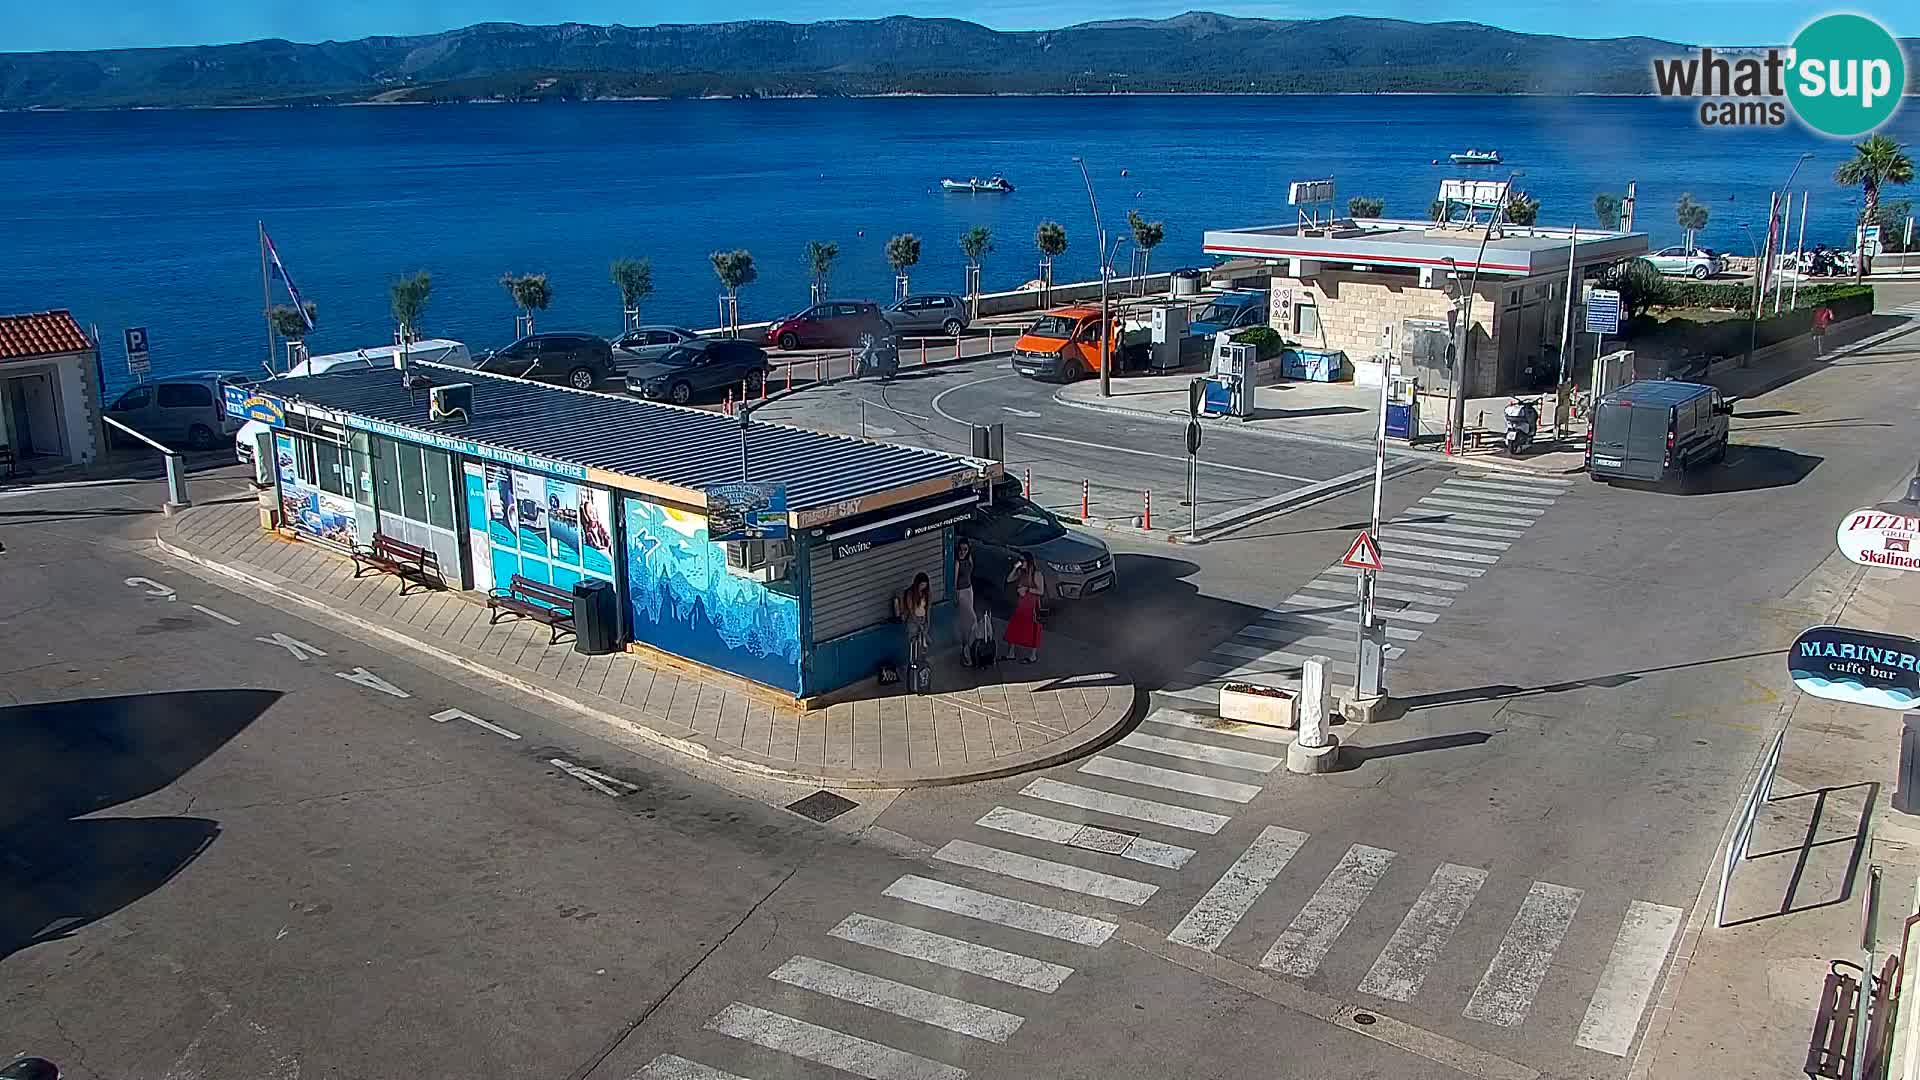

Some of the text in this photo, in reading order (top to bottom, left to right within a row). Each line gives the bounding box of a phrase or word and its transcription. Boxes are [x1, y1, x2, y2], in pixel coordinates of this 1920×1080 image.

[436, 437, 466, 452] POSTAJA
[478, 446, 492, 460] BUS
[494, 450, 526, 465] STATION
[527, 456, 555, 471] TICKET
[555, 462, 582, 478] OFFICE
[1881, 530, 1913, 540] GRILL
[1829, 661, 1897, 680] caffe bar
